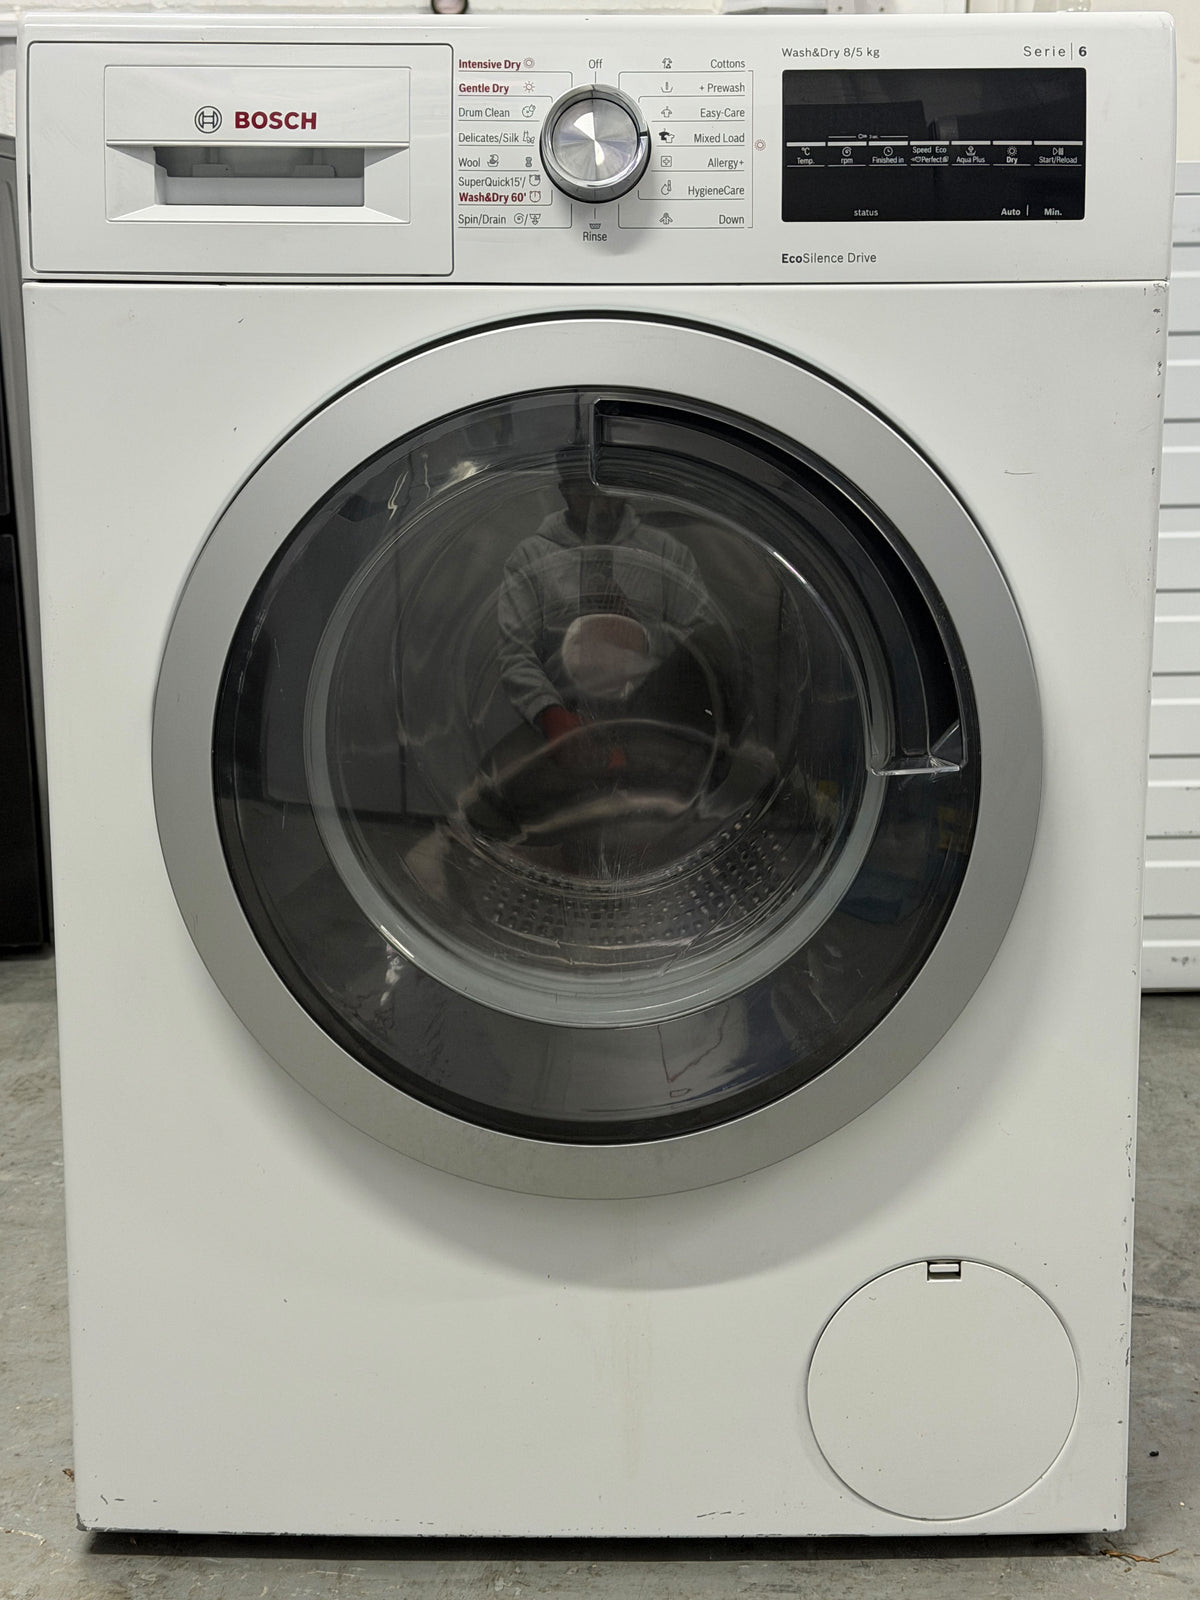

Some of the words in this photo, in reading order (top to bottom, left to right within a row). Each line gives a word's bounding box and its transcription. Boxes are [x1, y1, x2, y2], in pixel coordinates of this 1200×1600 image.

[781, 47, 840, 59] Wash&Dry
[843, 47, 863, 58] 8/5
[866, 47, 880, 58] kg
[1023, 45, 1066, 57] Serie
[1078, 46, 1087, 57] 6
[458, 59, 502, 69] Intensive
[503, 60, 521, 71] Dry
[588, 59, 603, 69] Off
[710, 59, 746, 69] Cottons
[458, 83, 490, 93] Gentle
[492, 84, 509, 95] Dry
[707, 83, 745, 93] Prewash
[458, 107, 483, 117] Drum
[484, 107, 510, 117] Clean
[700, 108, 745, 119] Easy-Care
[235, 111, 317, 130] BOSCH
[458, 132, 519, 143] Delicates/Silk
[693, 133, 721, 143] Mixed
[722, 133, 745, 143] Load
[912, 146, 932, 155] Speed
[458, 157, 481, 167] Wool
[707, 158, 744, 169] Allergy+
[797, 157, 815, 165] Temp.
[872, 156, 896, 164] Finished
[956, 156, 971, 164] Aqua
[1006, 156, 1018, 165] Dry
[1039, 156, 1078, 164] Start/Reload
[688, 186, 745, 197] HygieneCare
[459, 192, 509, 204] Wash&Dry
[1000, 208, 1021, 216] Auto
[1044, 208, 1063, 216] Min.
[458, 214, 507, 225] Spin/Drain
[719, 215, 745, 225] Down
[582, 232, 607, 242] Rinse
[781, 253, 844, 264] EcoSilence
[847, 253, 877, 263] Drive
